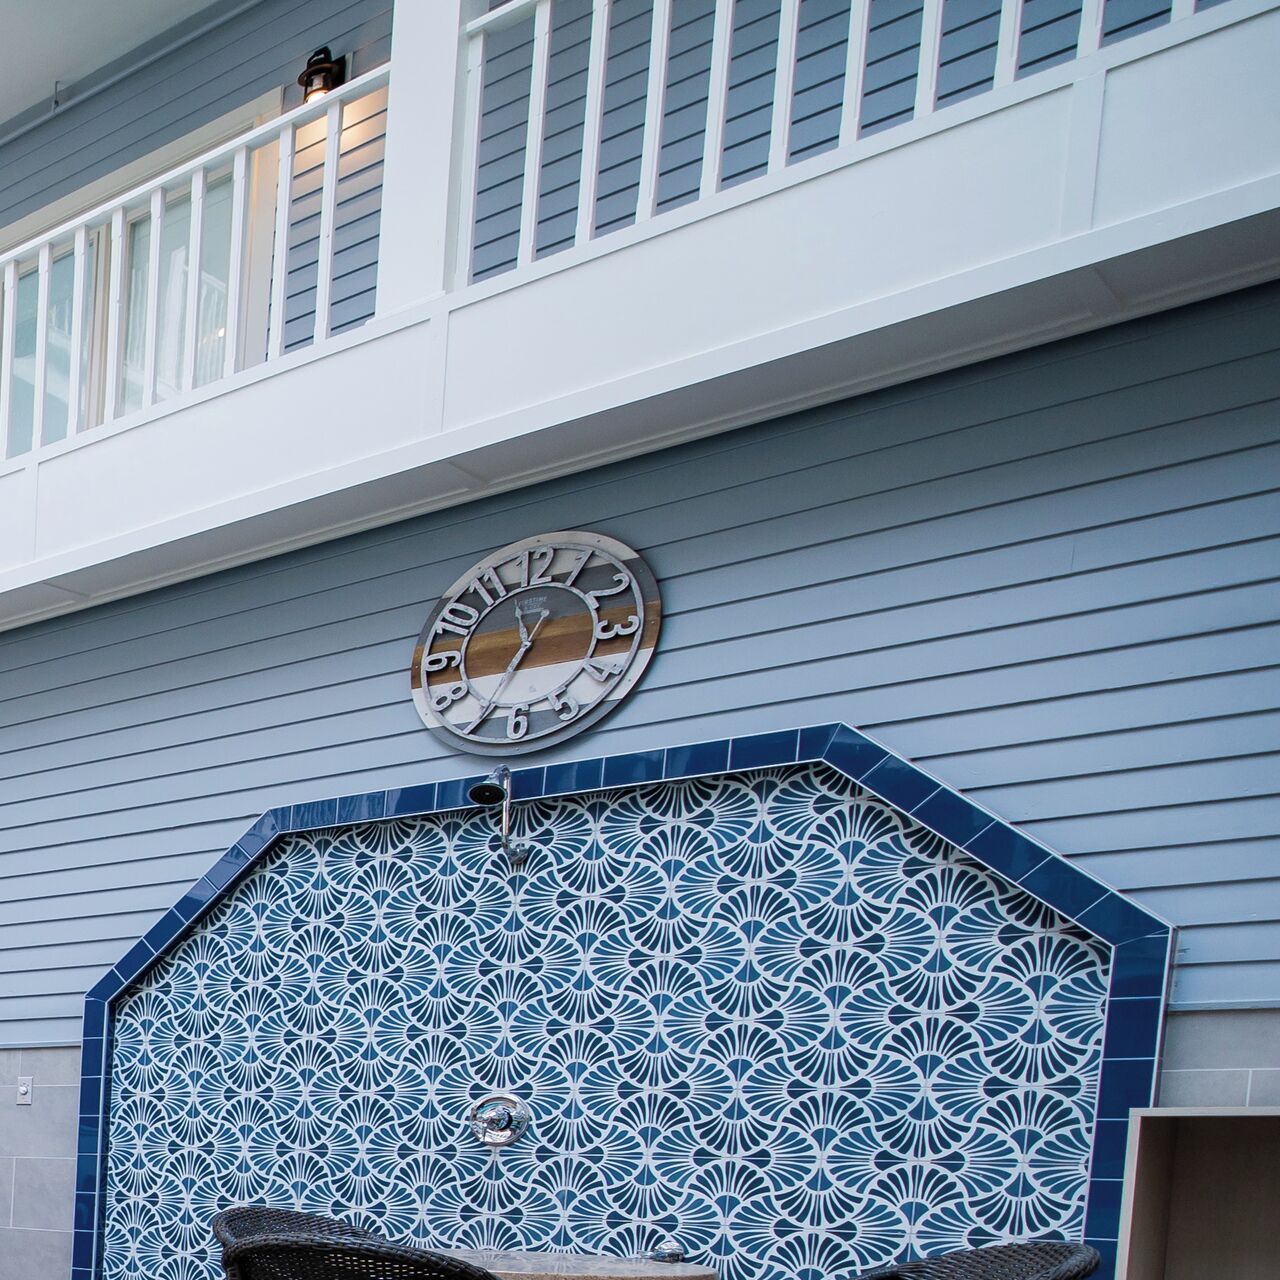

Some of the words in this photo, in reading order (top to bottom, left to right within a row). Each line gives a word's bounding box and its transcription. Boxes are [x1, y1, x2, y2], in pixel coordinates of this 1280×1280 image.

[468, 566, 507, 606] 11
[515, 548, 554, 588] 12
[564, 549, 594, 587] 1
[584, 573, 630, 610] 2
[435, 602, 480, 637] 10
[595, 615, 640, 640] 3
[424, 650, 462, 672] 9
[583, 658, 624, 683] 4
[433, 681, 468, 712] 8
[545, 685, 580, 722] 5
[506, 703, 529, 740] 6
